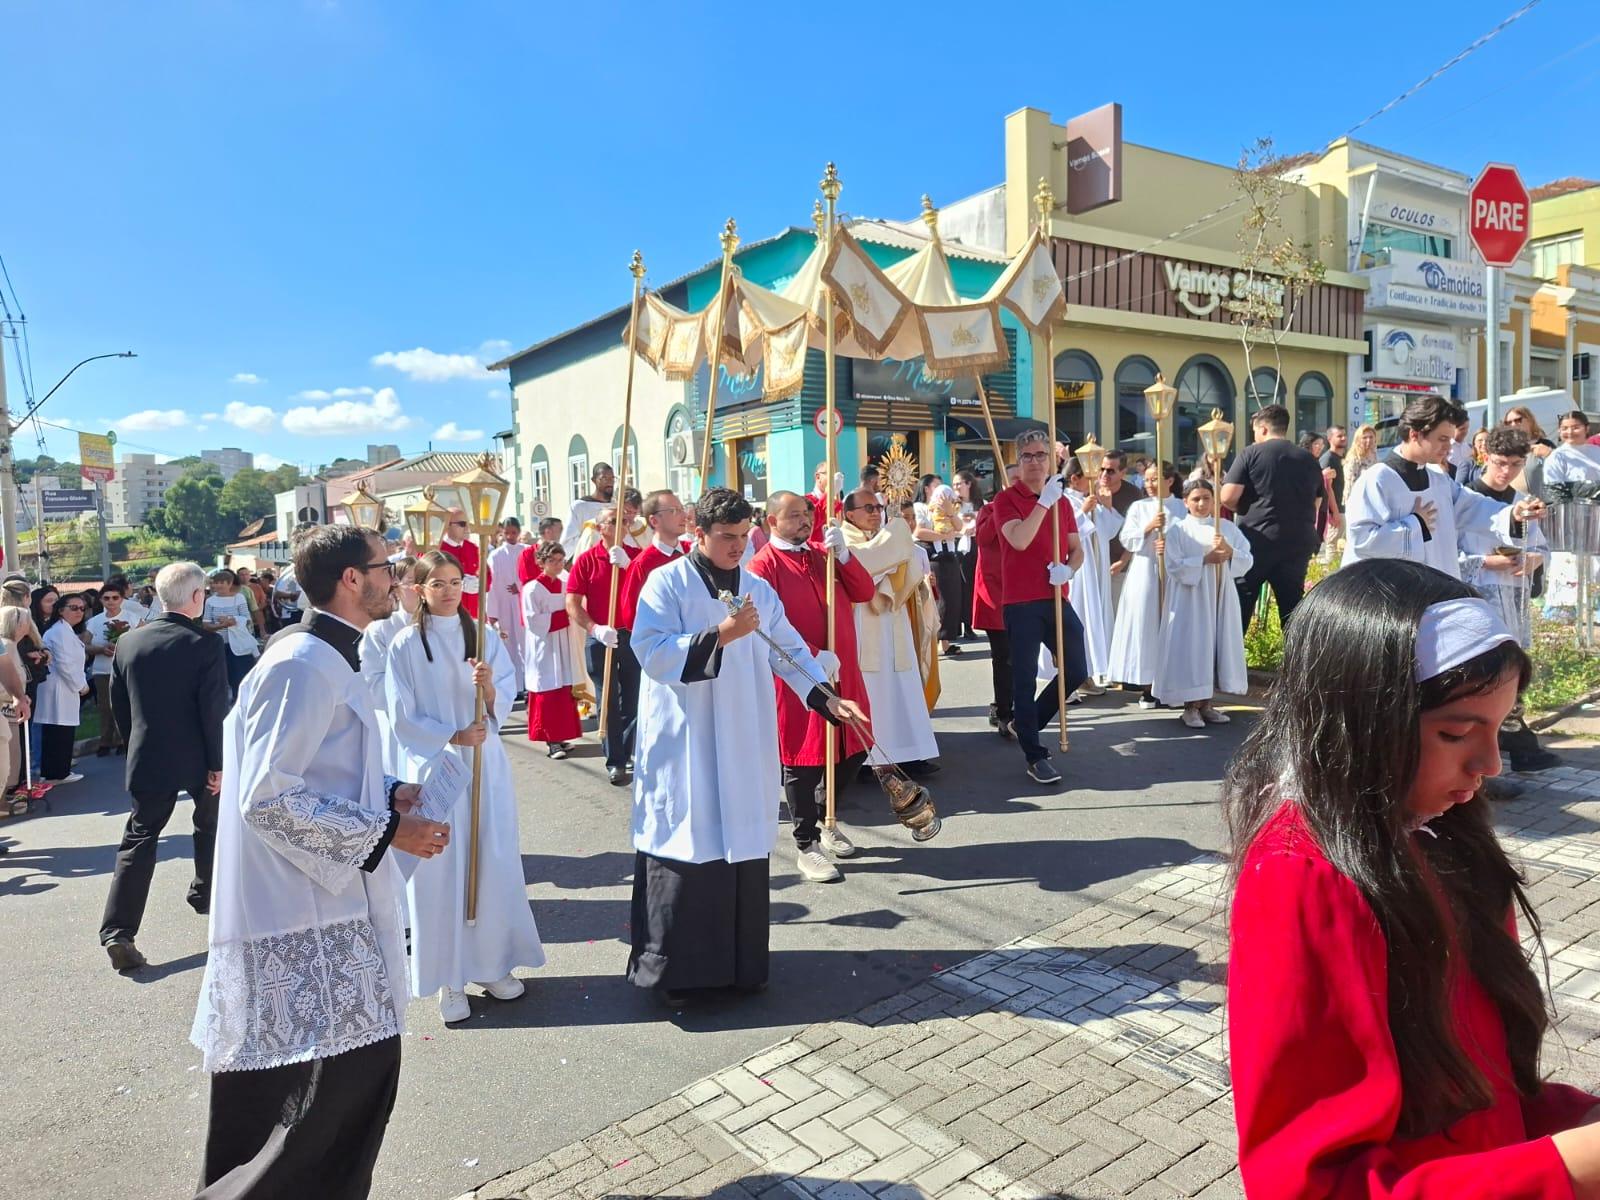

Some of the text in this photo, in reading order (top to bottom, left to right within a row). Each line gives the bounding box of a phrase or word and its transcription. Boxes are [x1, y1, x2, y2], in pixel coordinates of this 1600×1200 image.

[1390, 205, 1435, 227] ÓCULOS
[1475, 199, 1524, 232] PARE
[1164, 260, 1230, 297] Vamos
[1432, 269, 1482, 297] Demótica
